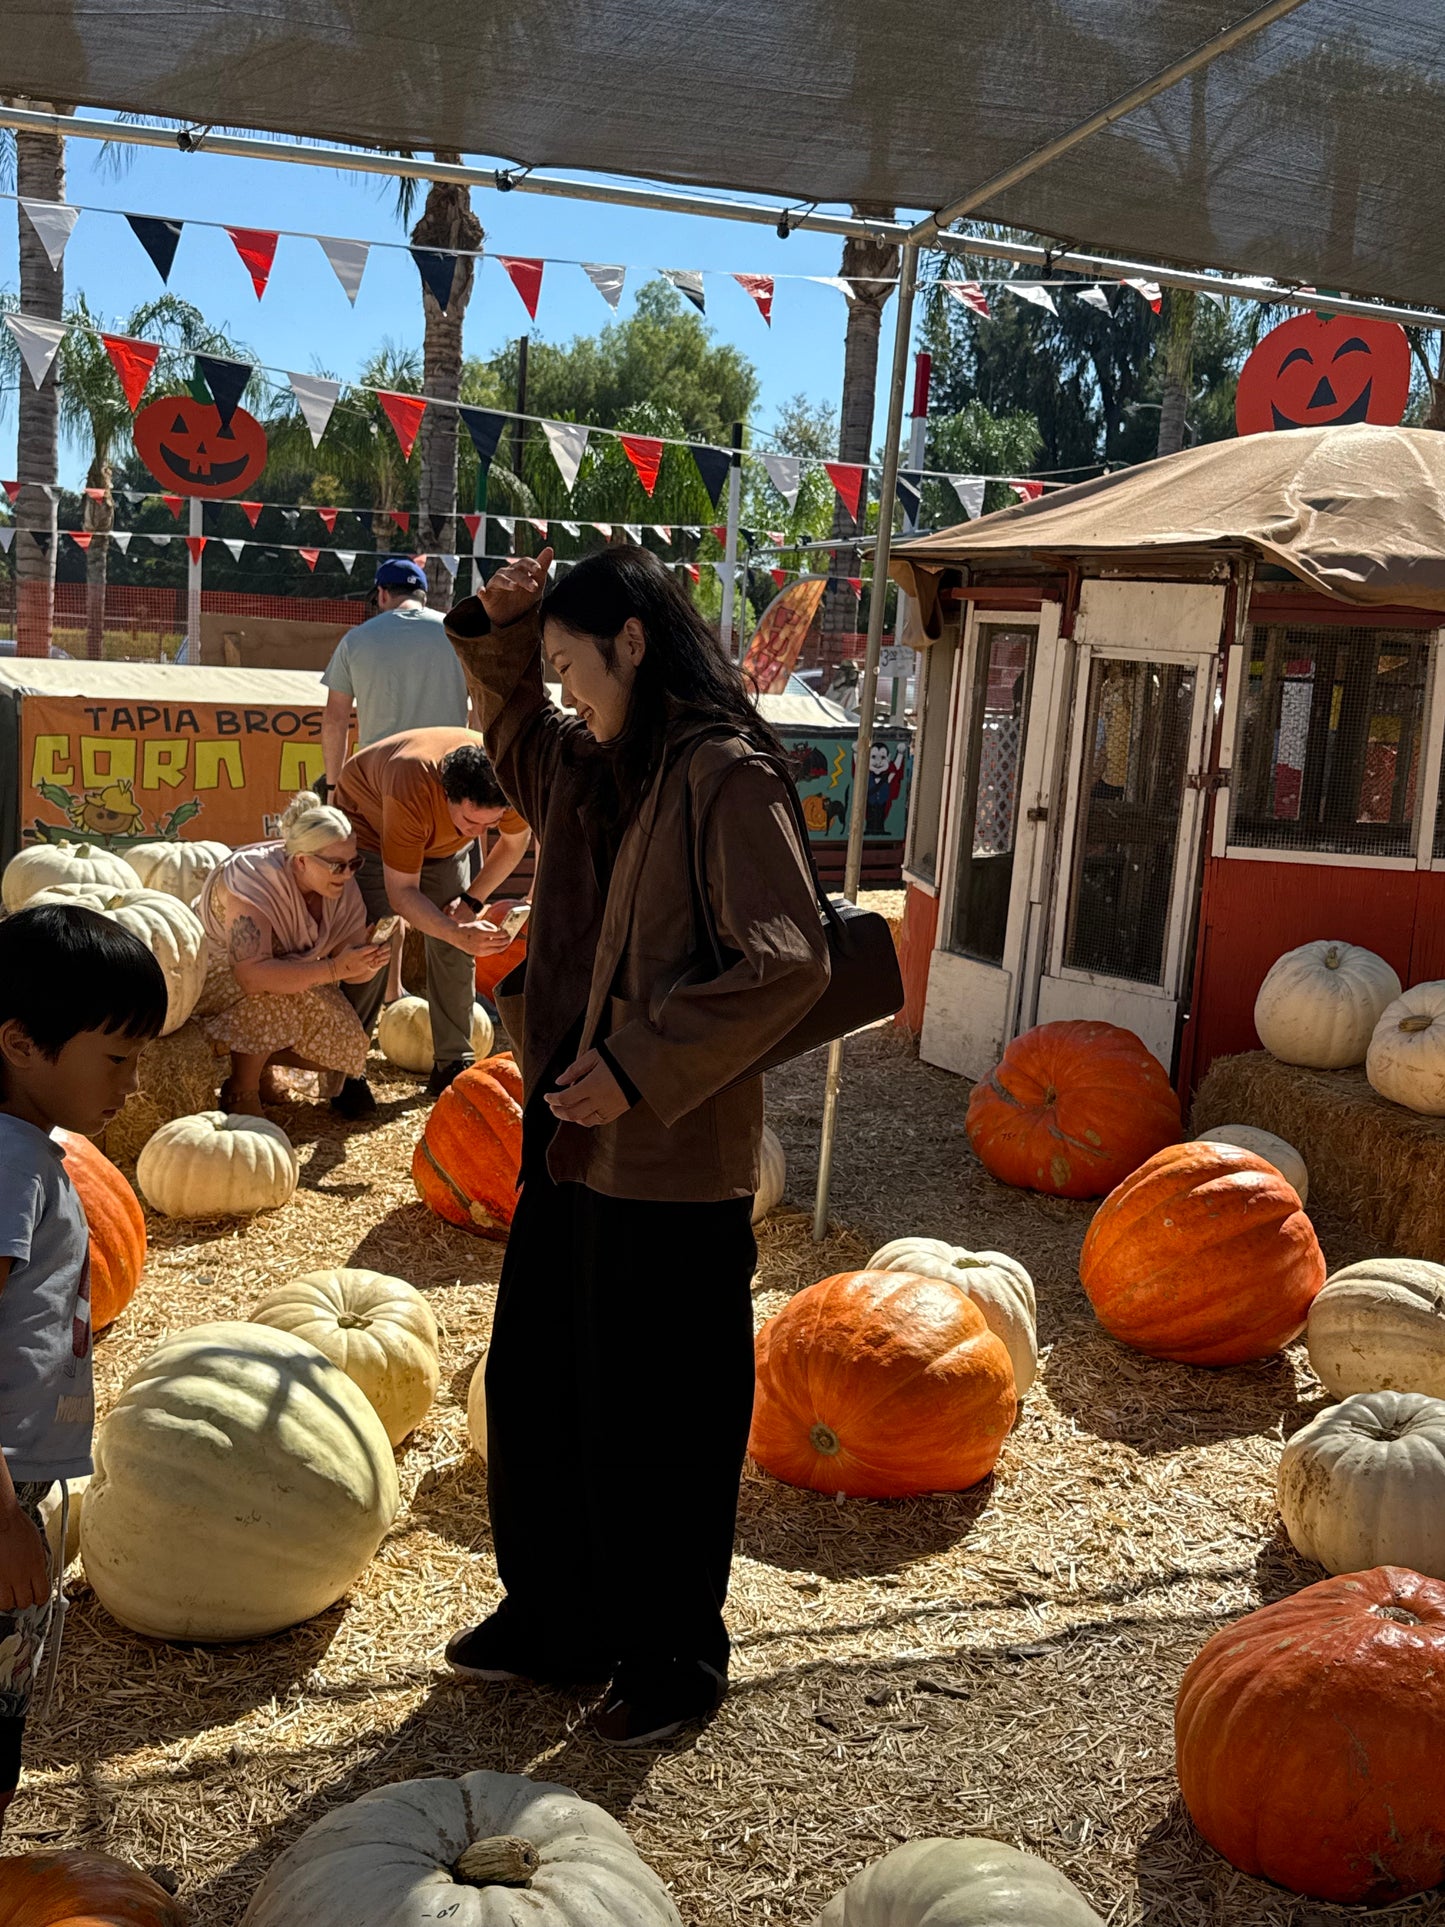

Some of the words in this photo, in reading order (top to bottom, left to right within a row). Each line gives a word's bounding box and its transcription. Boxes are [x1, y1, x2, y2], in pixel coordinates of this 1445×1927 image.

[84, 705, 200, 734] TAPIA
[215, 710, 323, 736] BROS
[31, 734, 245, 791] CORN
